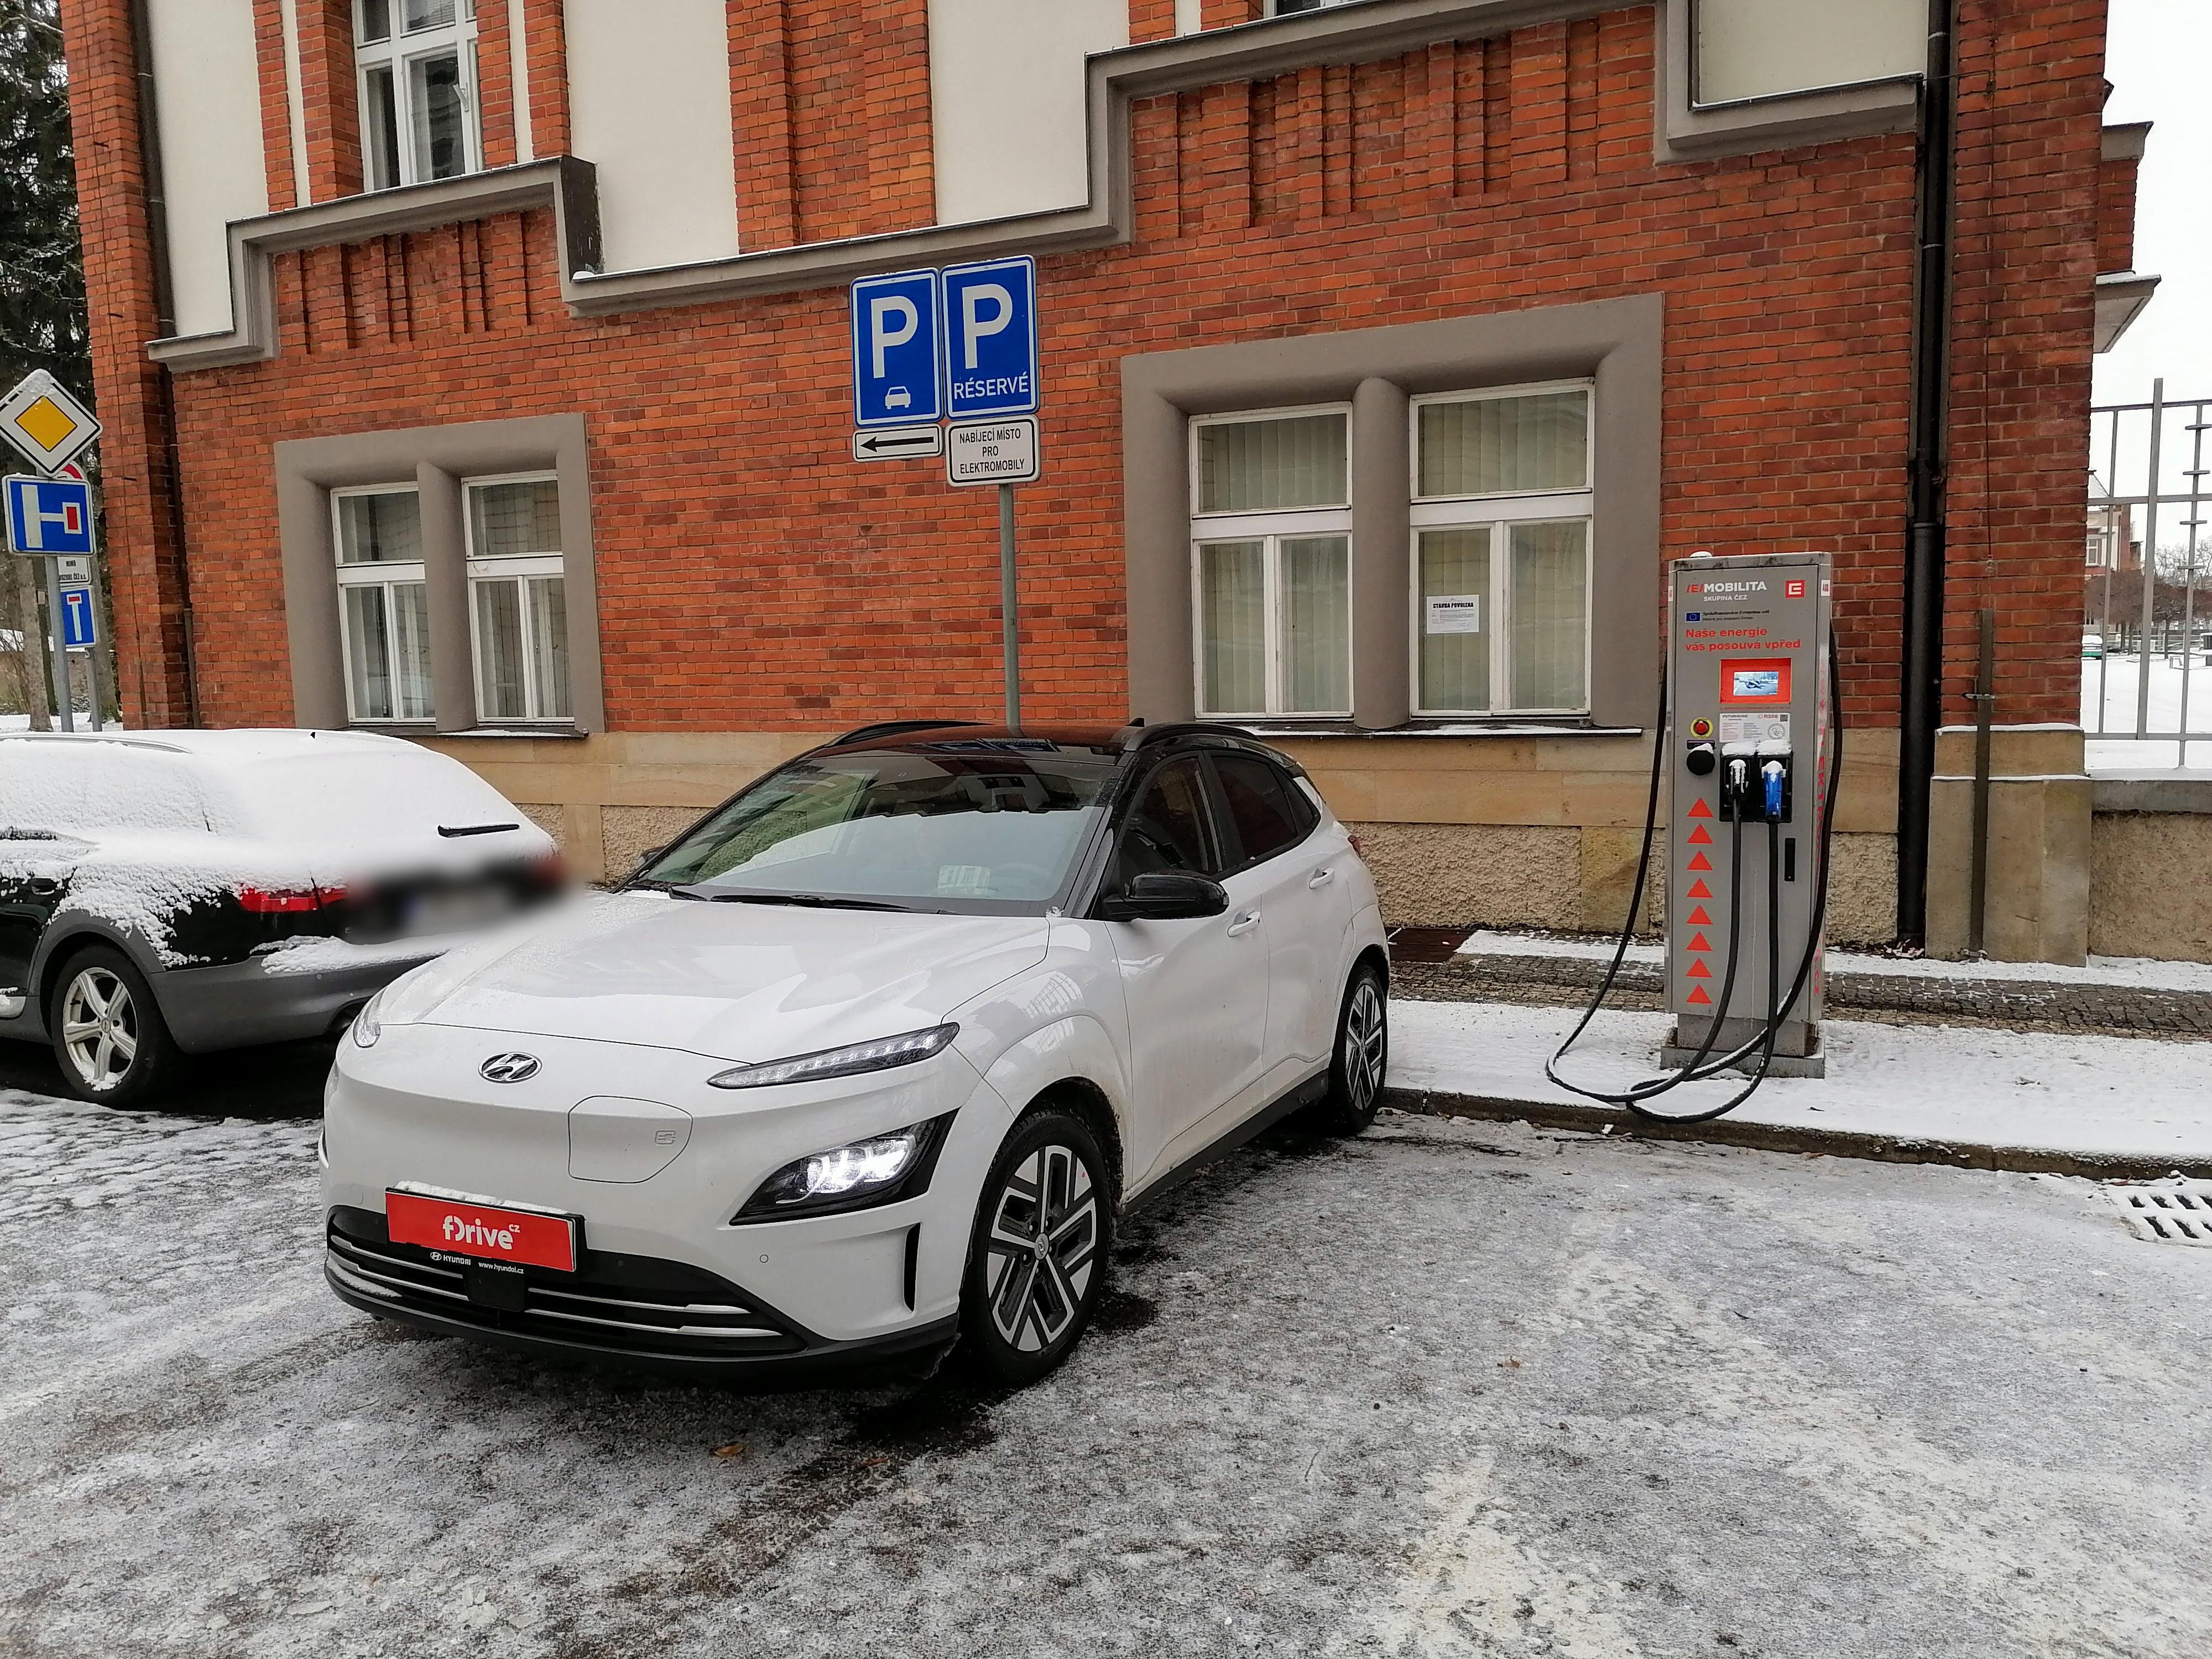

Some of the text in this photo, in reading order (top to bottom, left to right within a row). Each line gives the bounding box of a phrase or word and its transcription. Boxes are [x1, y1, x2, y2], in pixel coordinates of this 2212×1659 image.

[962, 283, 1013, 369] P
[871, 295, 918, 379] P
[953, 371, 1029, 400] RÉSERVÉ
[959, 426, 1021, 444] NABÍJECÍ MÍSTO
[982, 446, 999, 457] PRO
[960, 458, 1025, 474] ELEKTROMOBILY
[1686, 627, 1767, 638] Naše energie
[1686, 639, 1801, 652] vás posouvá vpřed
[443, 1254, 471, 1266] HYUNDAI
